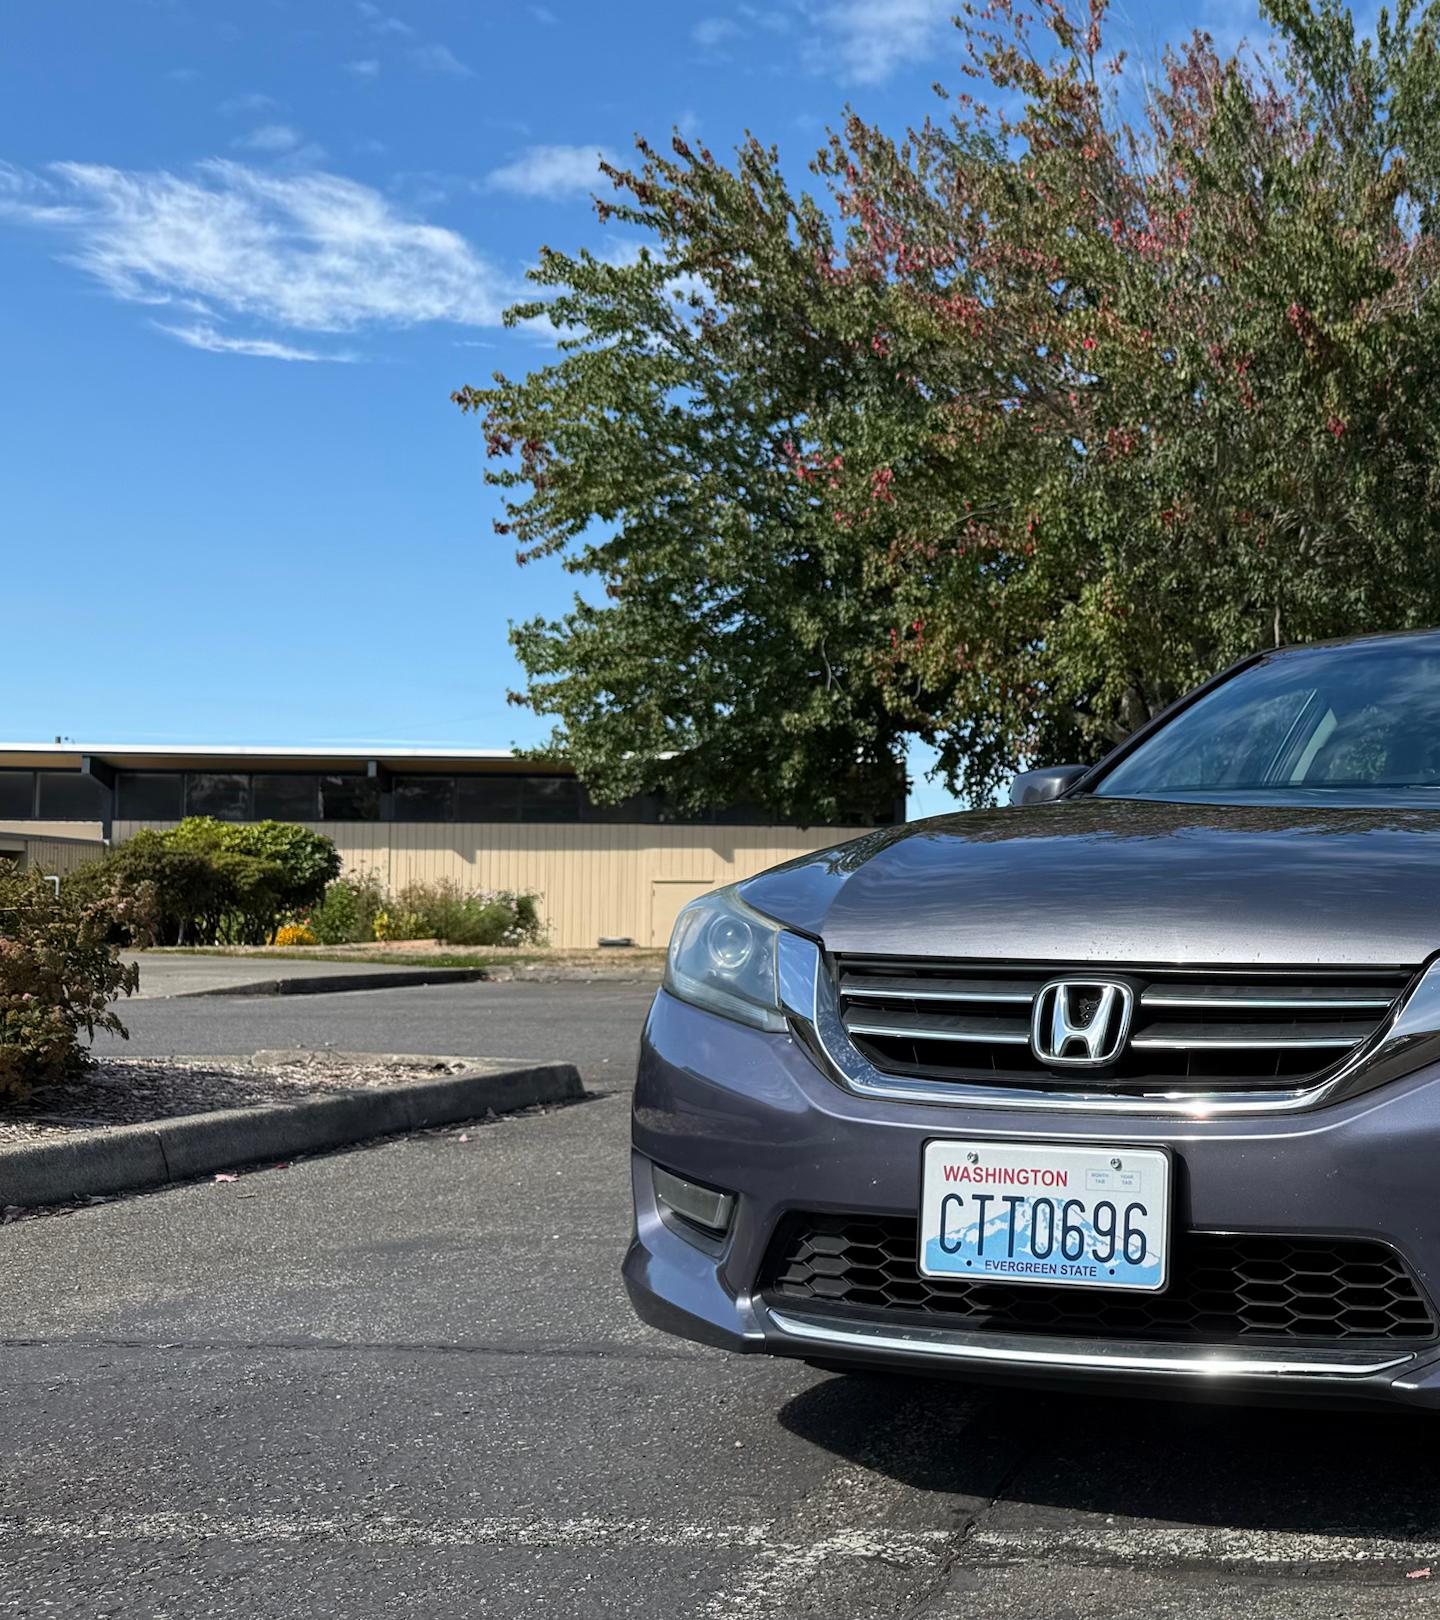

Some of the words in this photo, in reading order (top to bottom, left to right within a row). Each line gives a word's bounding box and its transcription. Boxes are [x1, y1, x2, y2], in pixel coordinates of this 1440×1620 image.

[943, 1165, 1068, 1187] WASHINGTON
[939, 1193, 1148, 1265] CTT0696
[985, 1260, 1057, 1275] EVERGREEN
[1060, 1264, 1097, 1277] STATE
